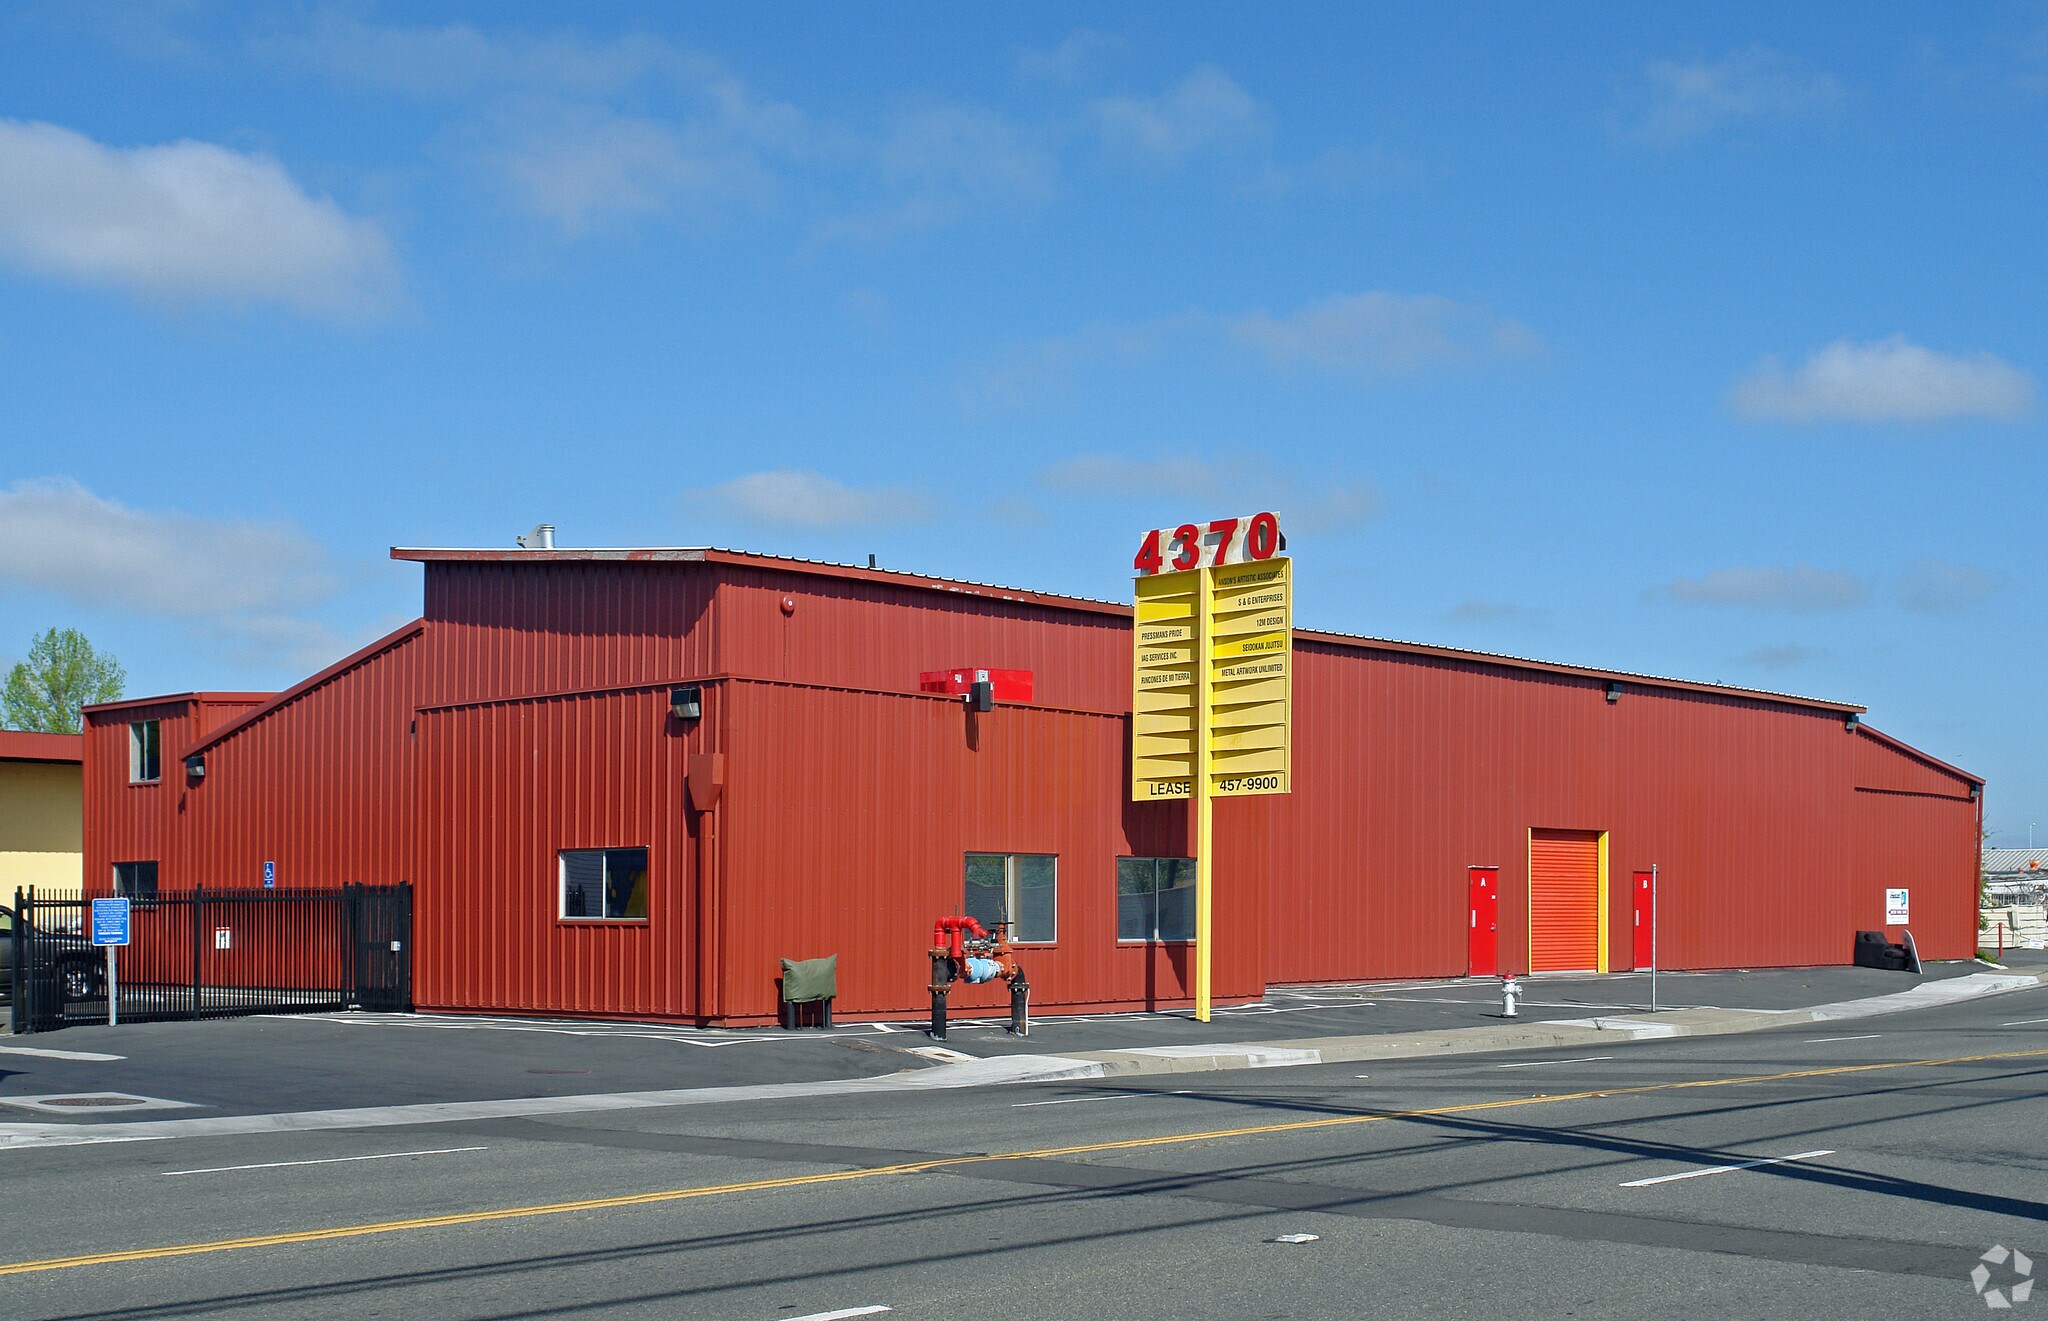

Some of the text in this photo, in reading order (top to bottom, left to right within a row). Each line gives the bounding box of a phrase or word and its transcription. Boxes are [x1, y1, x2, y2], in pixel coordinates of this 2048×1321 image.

[1134, 512, 1277, 575] 4370
[1237, 574, 1256, 583] ARTISTIC
[1257, 570, 1284, 581] ASSOCIATES
[1238, 593, 1283, 606] S & G ENTERPRISES
[1266, 616, 1284, 626] DESIGN
[1141, 629, 1182, 640] PRESSMANS PRIDE
[1242, 640, 1283, 652] SEIDOKAN JUJITSU
[1149, 652, 1169, 661] SERVICES
[1221, 663, 1283, 677] METAL ARTWORK UNLIMITED
[1141, 675, 1162, 684] RINCONES
[1162, 674, 1168, 683] DE
[1174, 673, 1190, 681] TIERRA
[1150, 776, 1278, 796] LEASE 457-9900
[1480, 877, 1486, 887] A
[1642, 880, 1648, 889] B
